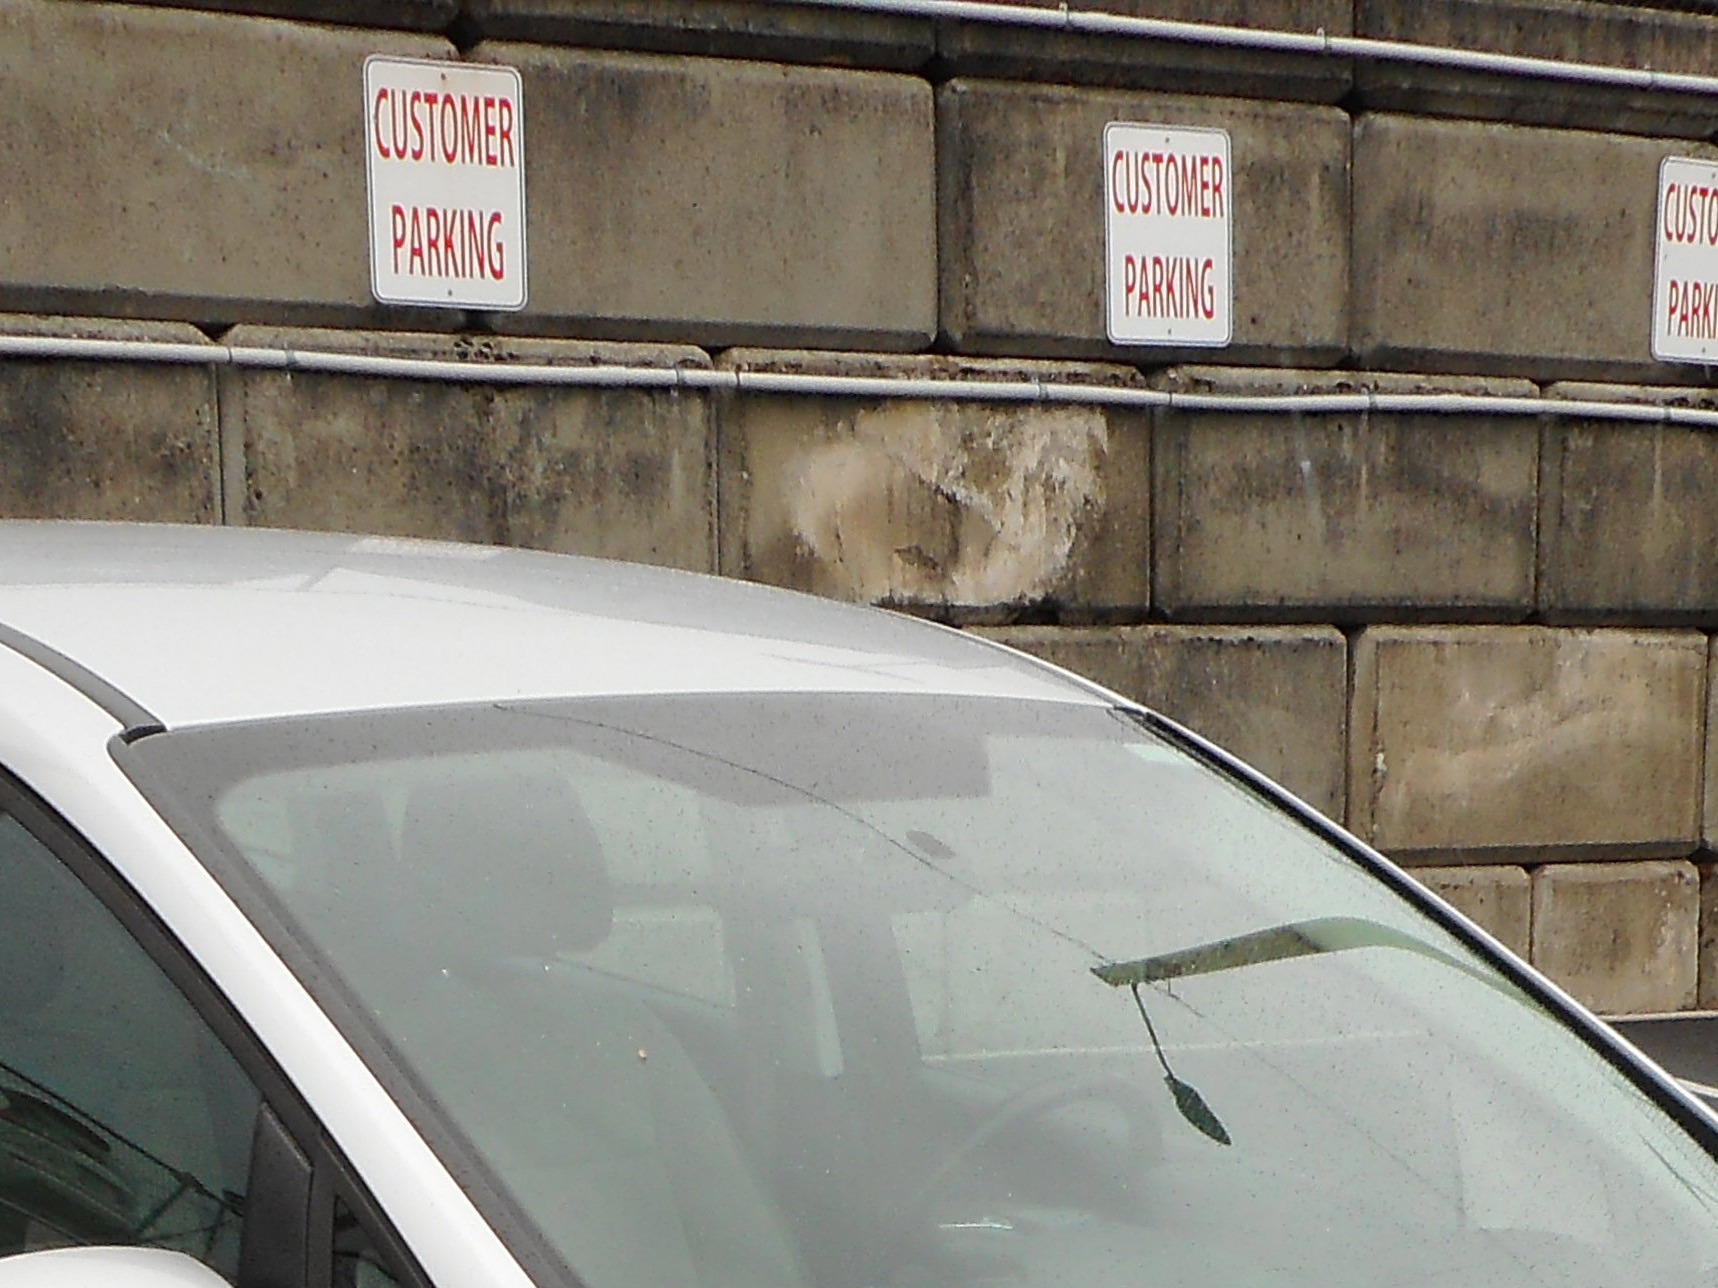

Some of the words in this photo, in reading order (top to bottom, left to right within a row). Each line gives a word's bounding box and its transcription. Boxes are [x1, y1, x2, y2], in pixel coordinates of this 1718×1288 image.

[374, 88, 515, 167] CUSTOMER
[1112, 150, 1224, 218] CUSTOMER
[392, 205, 504, 280] PARKING
[1125, 255, 1214, 319] PARKING
